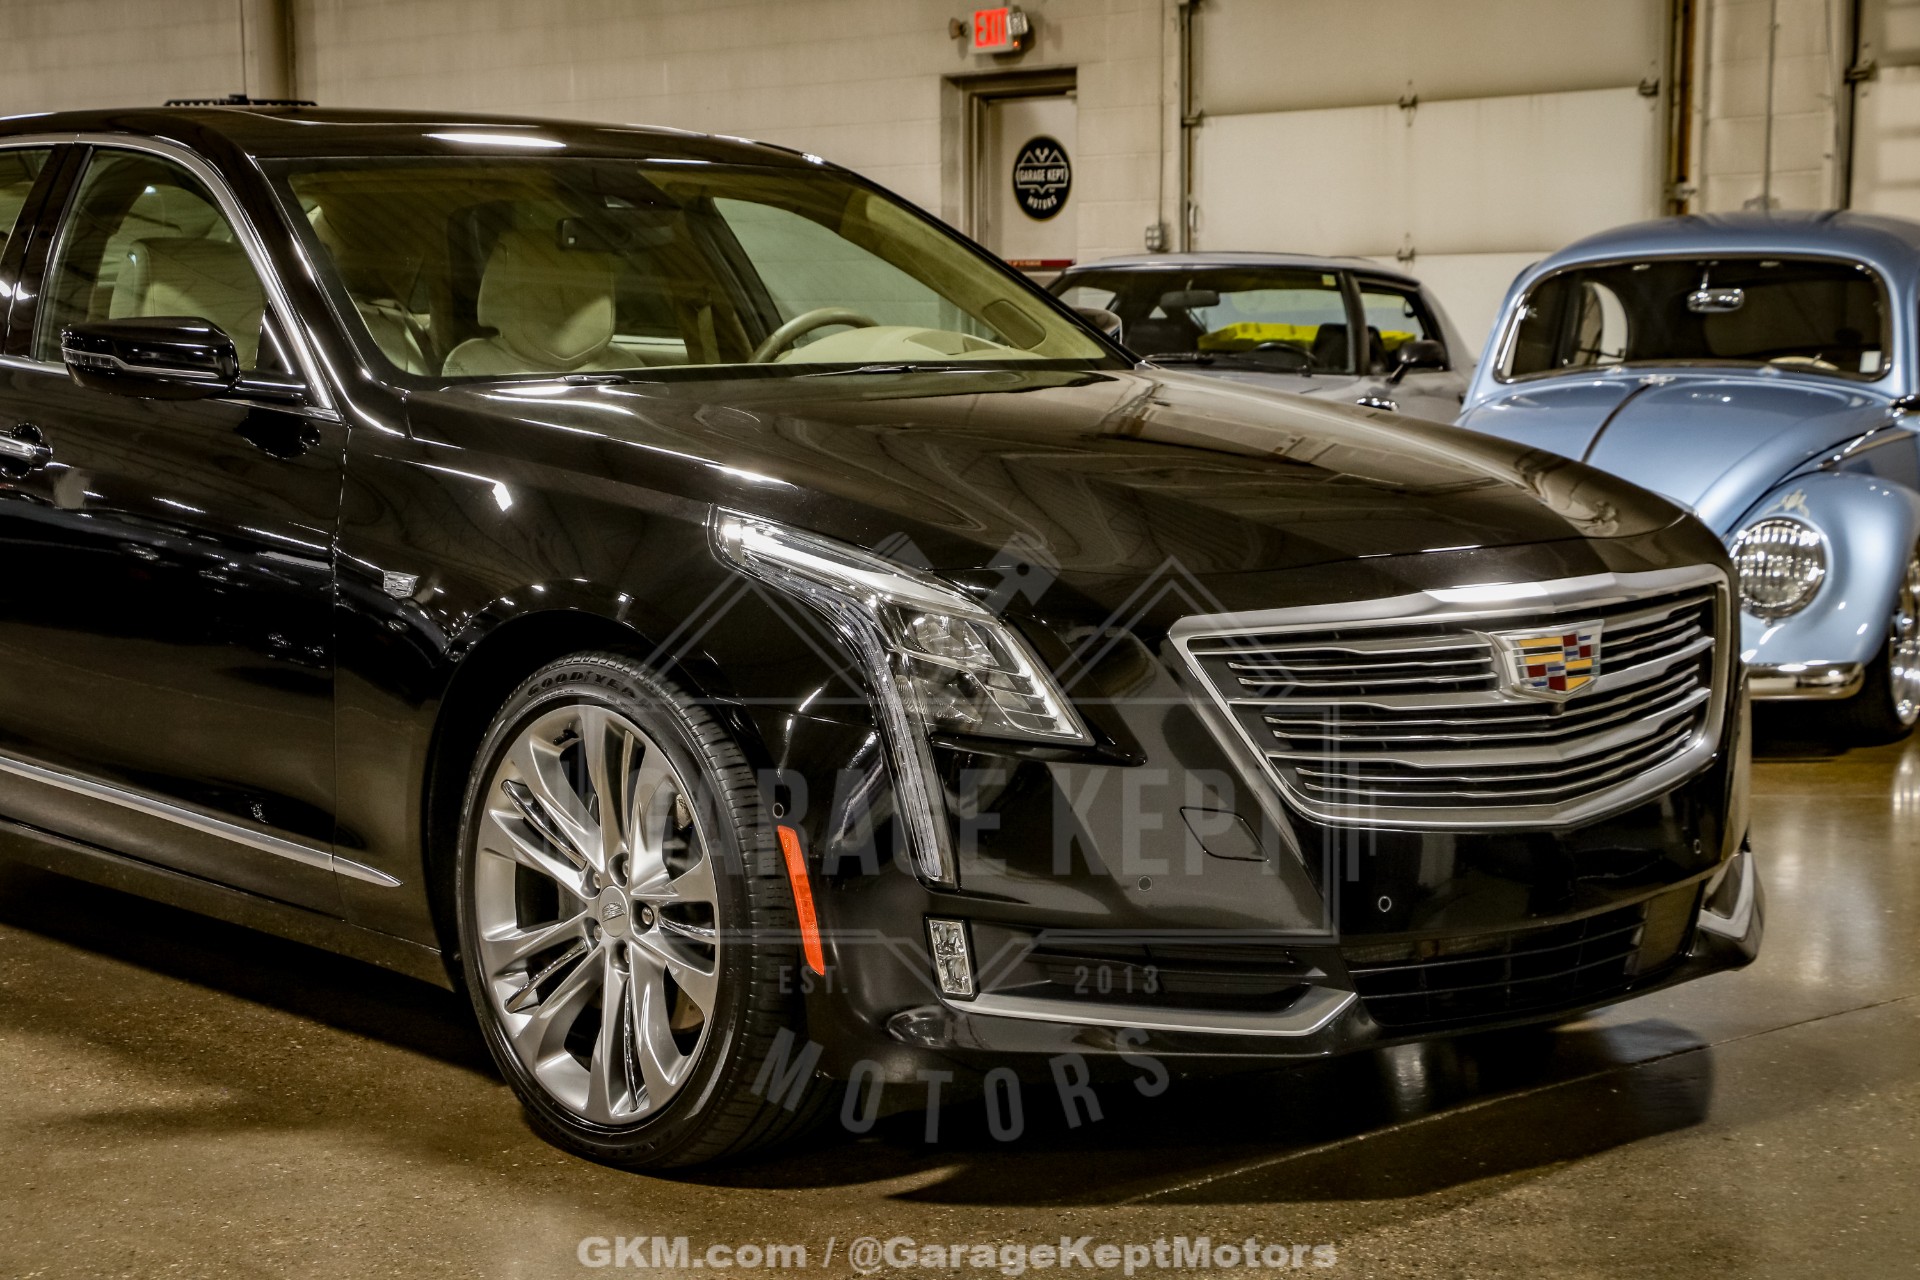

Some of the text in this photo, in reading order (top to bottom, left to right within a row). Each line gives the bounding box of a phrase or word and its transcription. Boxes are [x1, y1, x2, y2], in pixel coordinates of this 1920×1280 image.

[974, 7, 1008, 48] EXIT
[1020, 167, 1064, 182] GARAGE KEPT
[1027, 194, 1057, 210] MOTORS
